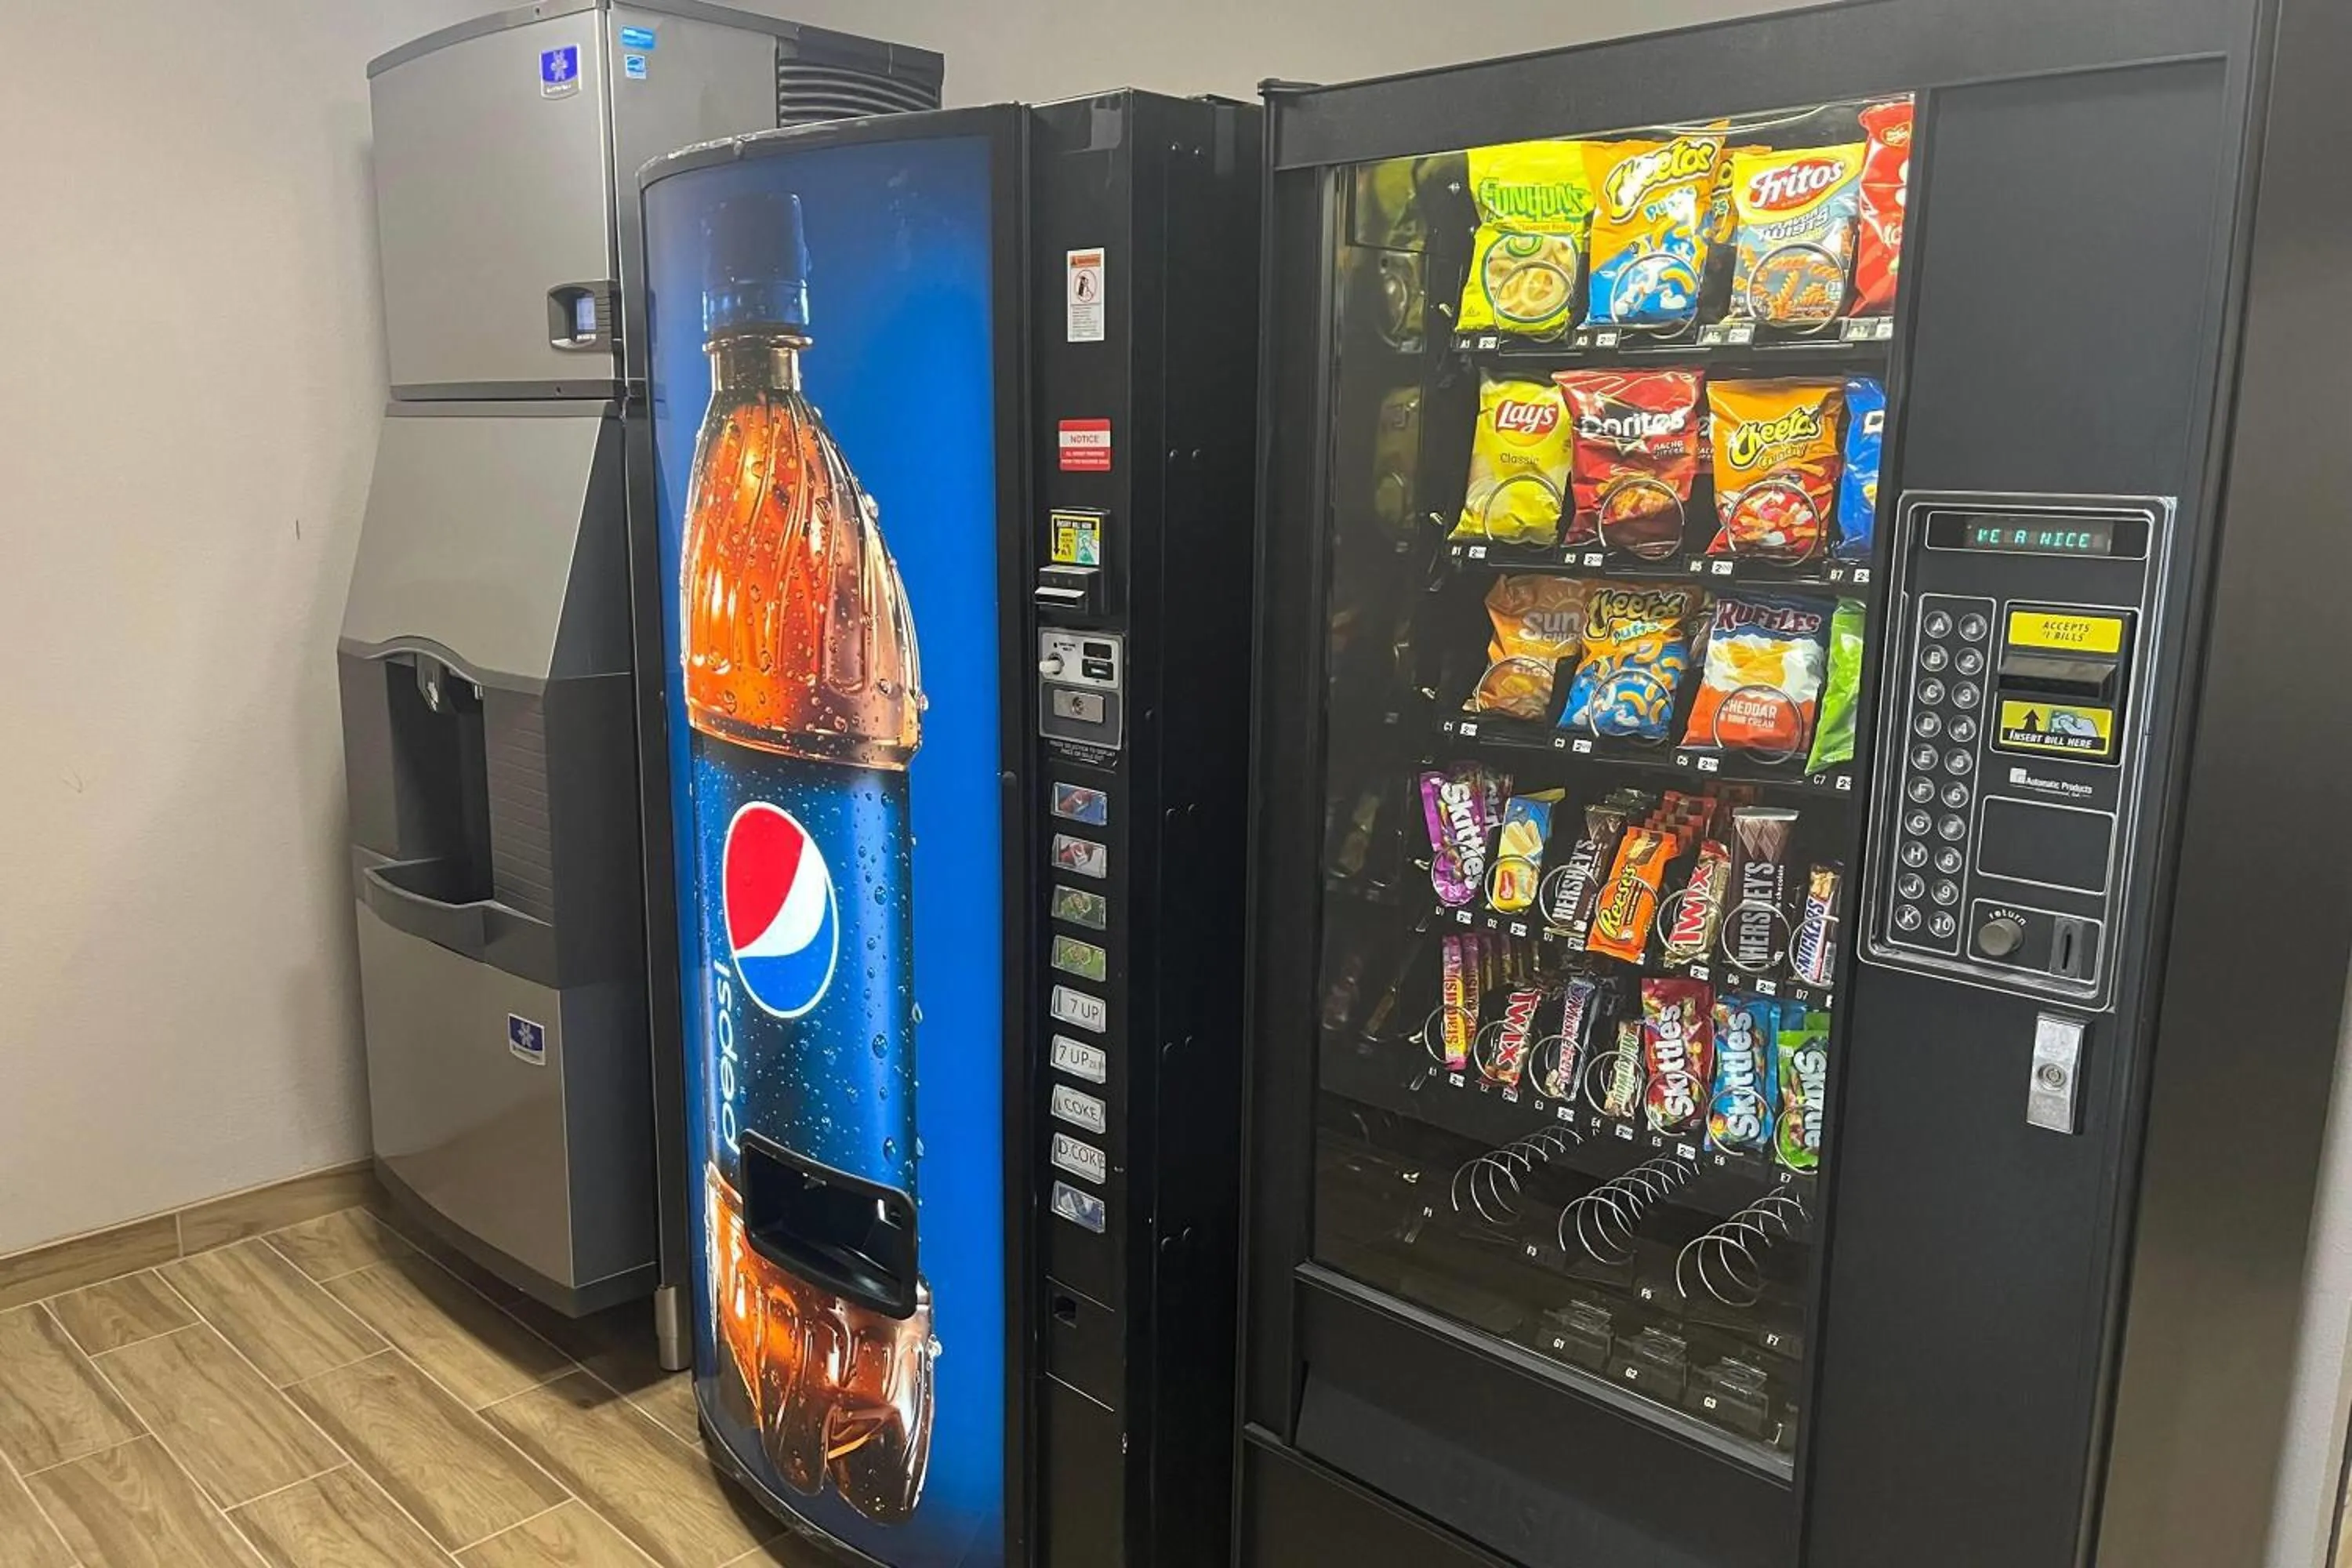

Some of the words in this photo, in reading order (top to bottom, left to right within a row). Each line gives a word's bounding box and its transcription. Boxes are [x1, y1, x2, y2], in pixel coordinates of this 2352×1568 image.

[1749, 159, 1845, 208] Fritos
[1070, 434, 1099, 444] NOTICE
[1730, 407, 1821, 468] Cheetos
[1977, 528, 2001, 543] VE
[2014, 529, 2027, 544] A
[2040, 531, 2091, 548] NICE
[1718, 600, 1820, 631] RUFFLES
[1519, 612, 1581, 641] Sun
[1932, 618, 1944, 630] A
[2043, 621, 2091, 633] ACCEPTS
[2054, 632, 2085, 642] BILLS
[1930, 652, 1940, 664] B
[1965, 655, 1975, 668] 2
[1927, 685, 1937, 698] C
[1962, 689, 1971, 702] 3
[1923, 718, 1934, 731] D
[2009, 729, 2043, 742] INSERT
[2044, 735, 2064, 746] BILL
[2068, 738, 2092, 749] HERE
[1921, 750, 1931, 763] E
[1918, 783, 1929, 795] F
[2026, 777, 2060, 789] Automatic
[2061, 782, 2092, 794] Products
[1951, 788, 1961, 800] 6
[1913, 815, 1925, 829] G
[1911, 848, 1922, 860] H
[1945, 853, 1954, 866] 8
[1908, 879, 1918, 891] J
[1941, 885, 1950, 898] 9
[1739, 862, 1774, 960] HERSHEY'S
[1904, 910, 1916, 924] K
[1989, 909, 2027, 926] return
[1935, 917, 1949, 931] 10
[1069, 997, 1078, 1013] 7
[1082, 1002, 1099, 1020] UP
[713, 960, 741, 1154] pepsi
[1059, 1045, 1067, 1061] 7
[1071, 1048, 1089, 1065] UP
[1722, 1012, 1759, 1138] Skittles
[1064, 1098, 1098, 1121] COKE
